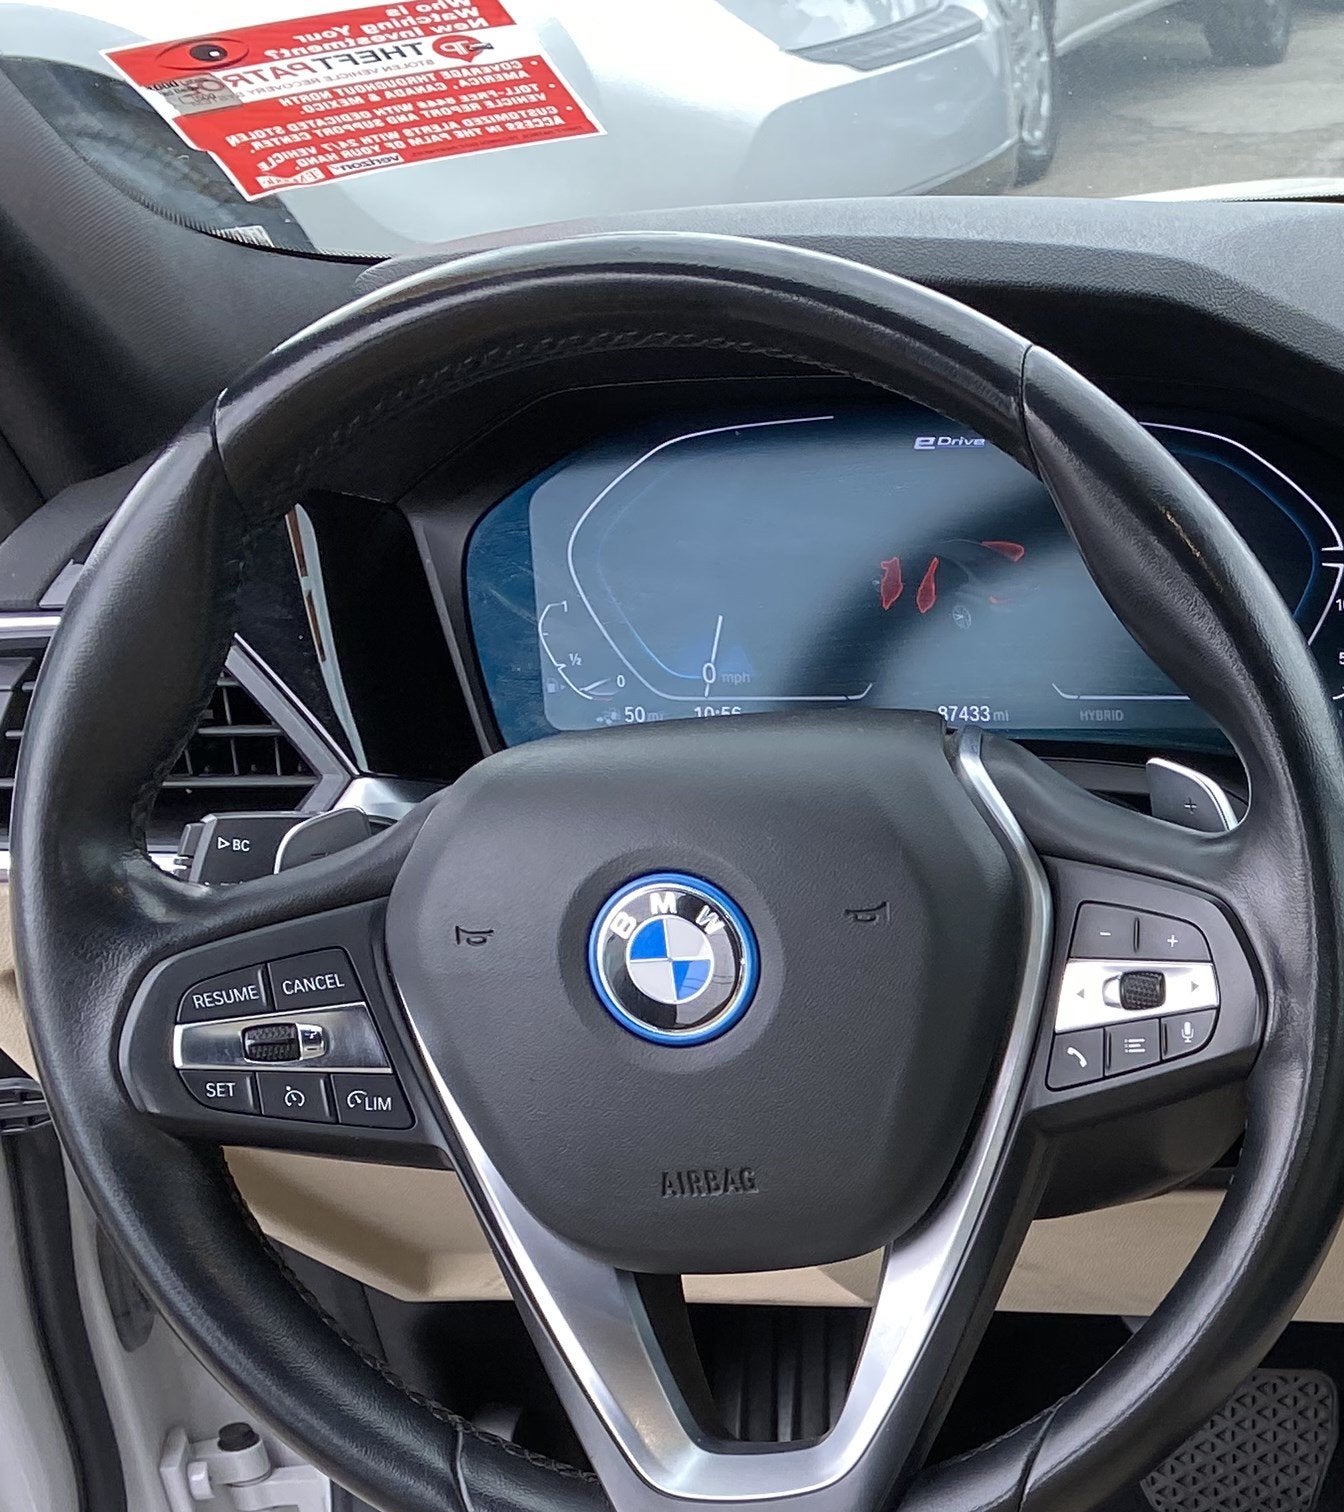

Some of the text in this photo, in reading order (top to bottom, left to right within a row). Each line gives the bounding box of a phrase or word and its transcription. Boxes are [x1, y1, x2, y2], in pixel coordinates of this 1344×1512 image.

[616, 674, 626, 687] 0
[703, 662, 750, 685] 0 mph
[624, 706, 646, 723] 50
[1080, 709, 1124, 723] HYBRID
[232, 839, 250, 852] BC
[609, 891, 726, 940] BMW
[281, 973, 345, 996] CANCEL
[192, 985, 260, 1009] RESUME
[205, 1082, 236, 1098] SET
[365, 1097, 392, 1111] LIM
[659, 1167, 760, 1199] AIRBAG
